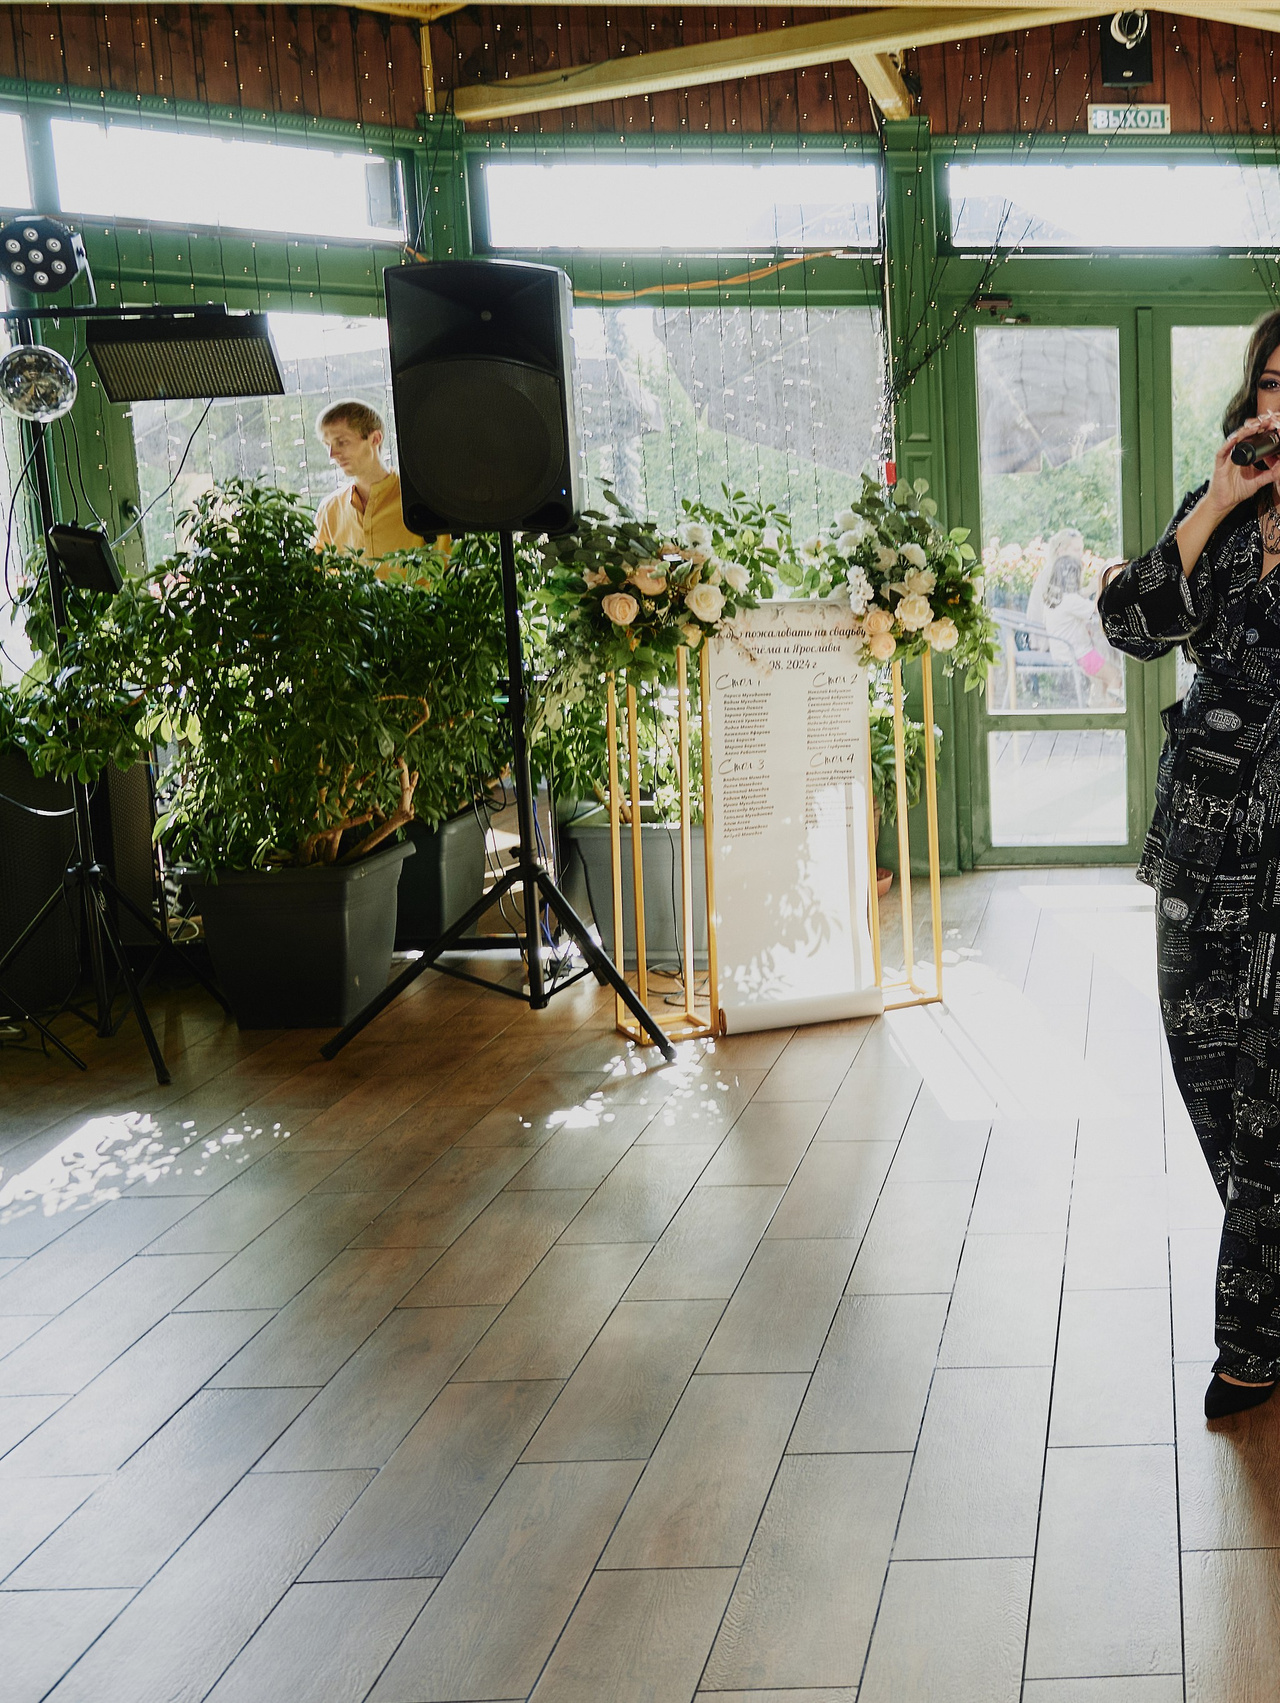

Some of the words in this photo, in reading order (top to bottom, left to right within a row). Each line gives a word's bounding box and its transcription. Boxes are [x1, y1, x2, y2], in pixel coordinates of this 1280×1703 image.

[1096, 110, 1163, 129] ВЫХОД
[745, 627, 812, 639] пожаловать
[814, 629, 827, 638] на
[829, 626, 867, 640] свадьбу
[793, 643, 841, 656] Ярославы
[786, 660, 810, 670] 2024
